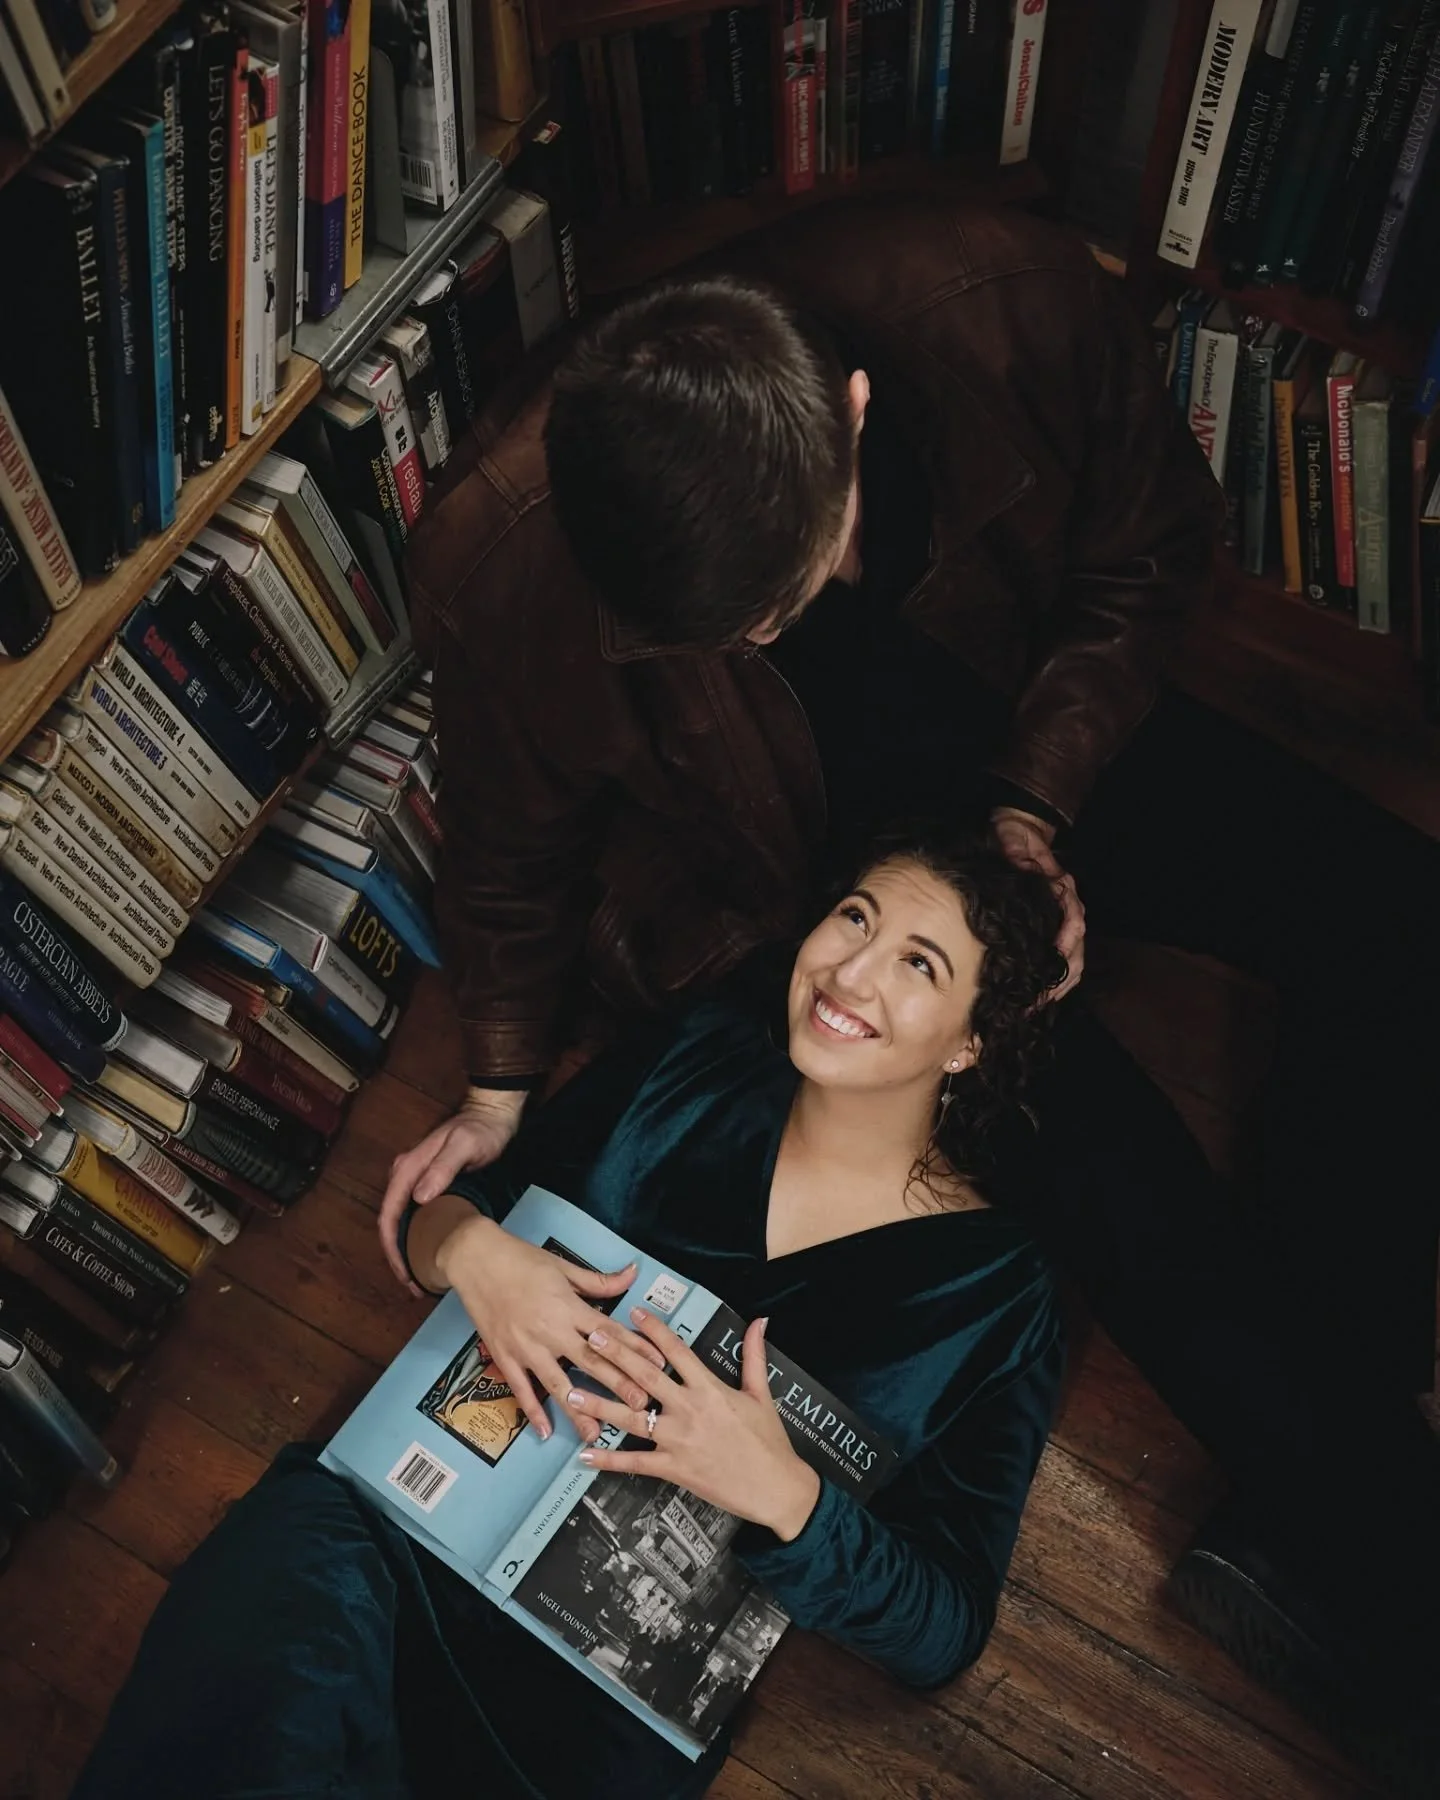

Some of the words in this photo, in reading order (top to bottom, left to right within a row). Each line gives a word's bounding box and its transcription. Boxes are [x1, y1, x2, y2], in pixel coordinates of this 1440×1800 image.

[207, 65, 224, 118] LET'S
[1198, 22, 1240, 114] MODERN
[352, 67, 365, 132] BOOK
[1396, 78, 1439, 172] ALEXANDER
[174, 125, 184, 169] DISCO
[207, 126, 224, 161] GO
[265, 134, 277, 181] LET'S
[1188, 112, 1216, 155] ART
[1221, 93, 1272, 223] HUNDERTWASSER
[164, 166, 176, 214] DANCE
[253, 160, 263, 210] ballroom
[351, 135, 363, 200] DANCE
[175, 174, 185, 220] DANCE
[207, 167, 225, 260] DANCING
[264, 186, 276, 255] DANCE
[166, 220, 177, 267] STEPS
[176, 227, 186, 272] STEPS
[252, 215, 262, 262] dancing
[350, 204, 361, 246] THE
[74, 226, 102, 325] BALLET
[155, 279, 171, 358] BALLET
[1307, 440, 1320, 461] The
[1336, 384, 1352, 473] McDonald's
[1306, 464, 1320, 498] Golden
[1306, 500, 1321, 520] Key
[187, 620, 210, 649] PUBLIC
[88, 681, 118, 716] WORLD
[114, 709, 162, 763] ARCHITECTURE
[157, 755, 168, 770] 3
[108, 655, 137, 689] WORLD
[132, 682, 179, 738] ARCHITECTURE
[176, 732, 186, 746] 4
[82, 728, 108, 758] Tempel
[66, 761, 96, 794] MEXICO'S
[93, 789, 121, 819] MODERN
[118, 814, 157, 857] ARCHITECTURE
[109, 756, 124, 774] New
[121, 769, 143, 794] Finnish
[140, 789, 172, 825] Architecture
[173, 824, 203, 858] Architectural
[199, 852, 215, 871] Press
[30, 811, 52, 835] Faber
[53, 833, 71, 853] New
[66, 846, 90, 872] Danish
[86, 865, 122, 902] Architecture
[122, 901, 155, 935] Architectural
[151, 929, 170, 949] Press
[50, 787, 76, 816] Galardi
[74, 813, 92, 832] New
[87, 826, 108, 850] Italian
[103, 843, 138, 880] Architecture
[138, 879, 170, 913] Architectural
[166, 908, 184, 928] Press
[13, 839, 41, 868] Besset
[38, 862, 57, 882] New
[53, 876, 77, 901] French
[72, 895, 109, 931] Architecture
[106, 927, 140, 961] Architectural
[136, 956, 155, 975] Press
[12, 900, 79, 984] CISTERCIAN
[75, 973, 113, 1025] ABBEYS
[348, 904, 401, 978] LOFTS
[211, 1077, 239, 1104] ENDLESS
[44, 1224, 75, 1256] CAFES
[71, 1243, 86, 1263] &
[82, 1251, 114, 1283] COFFEE
[110, 1271, 139, 1300] SHOPS
[709, 1348, 725, 1364] THE
[714, 1326, 785, 1390] LOT
[778, 1380, 881, 1472] EMPIRES
[561, 1471, 582, 1495] NIGEL
[816, 1438, 841, 1463] PRESENT
[842, 1461, 864, 1482] FUTURE
[531, 1495, 565, 1537] FOUNTAIN
[535, 1590, 562, 1614] NIGEL
[558, 1608, 599, 1643] FOUNTAIN
